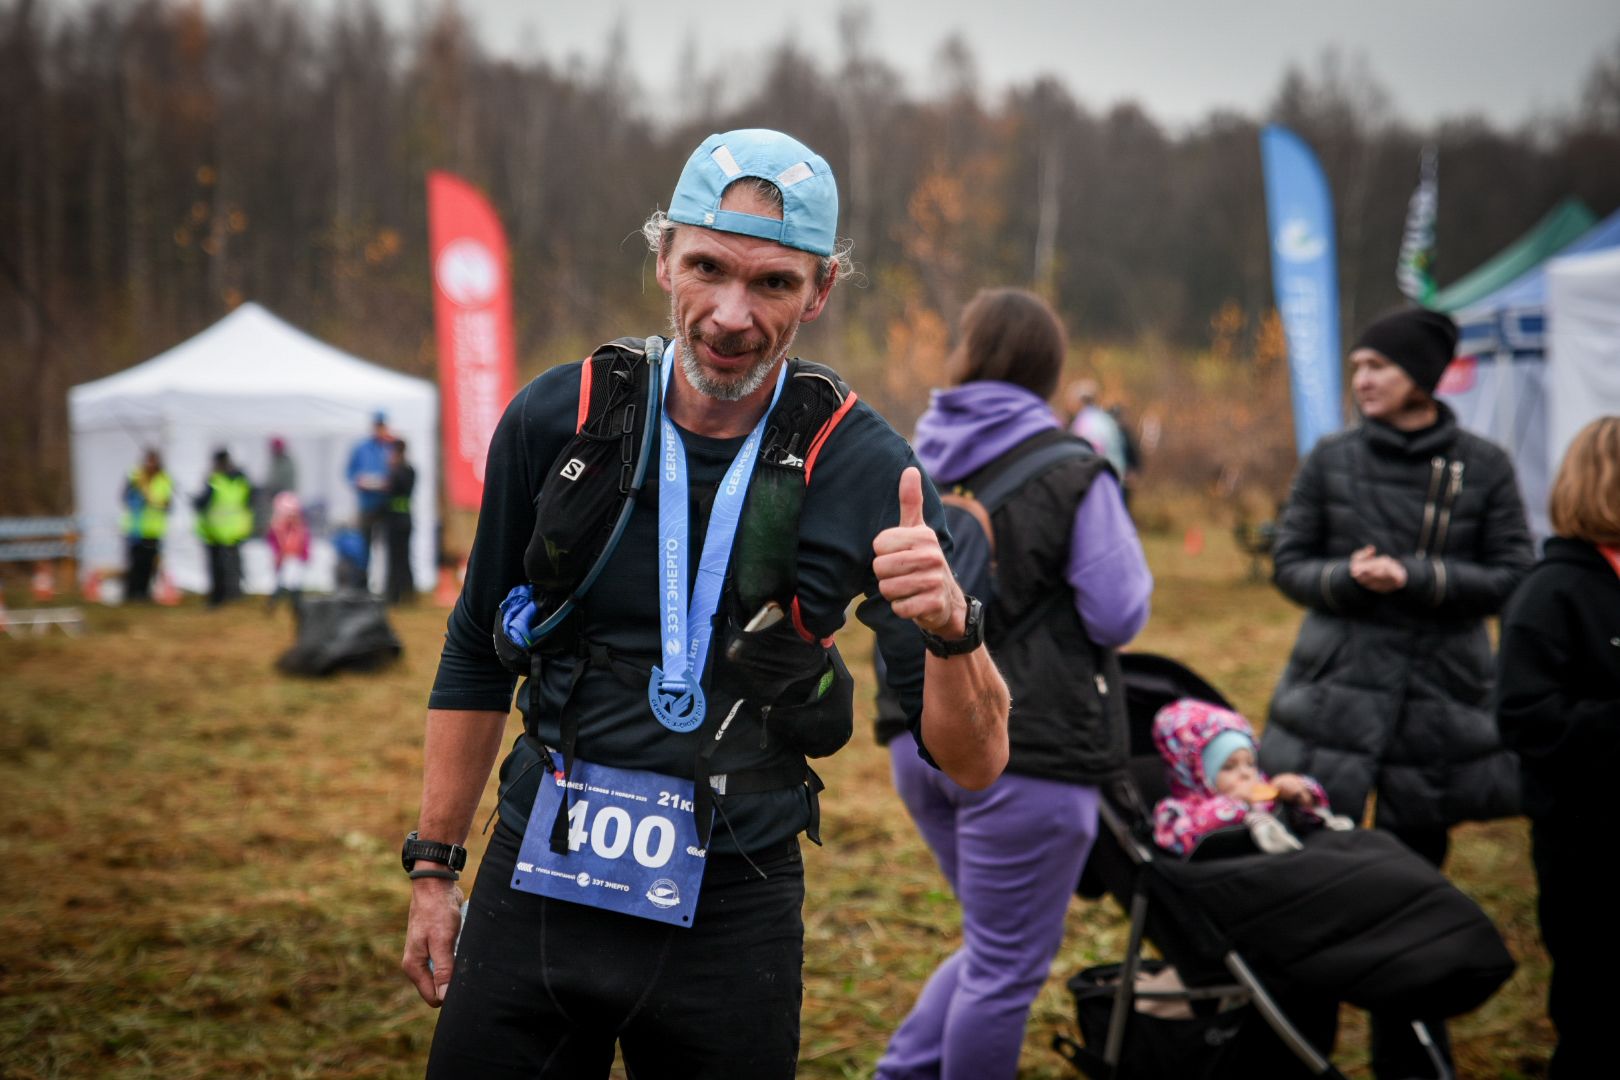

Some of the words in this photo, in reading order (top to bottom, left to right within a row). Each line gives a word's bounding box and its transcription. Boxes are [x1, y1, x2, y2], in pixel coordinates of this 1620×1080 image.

[665, 422, 677, 482] GERMES
[666, 538, 679, 601] ЭНЕРГО
[688, 639, 700, 660] km
[568, 800, 676, 868] 400
[604, 882, 630, 892] ЭНЕРГО
